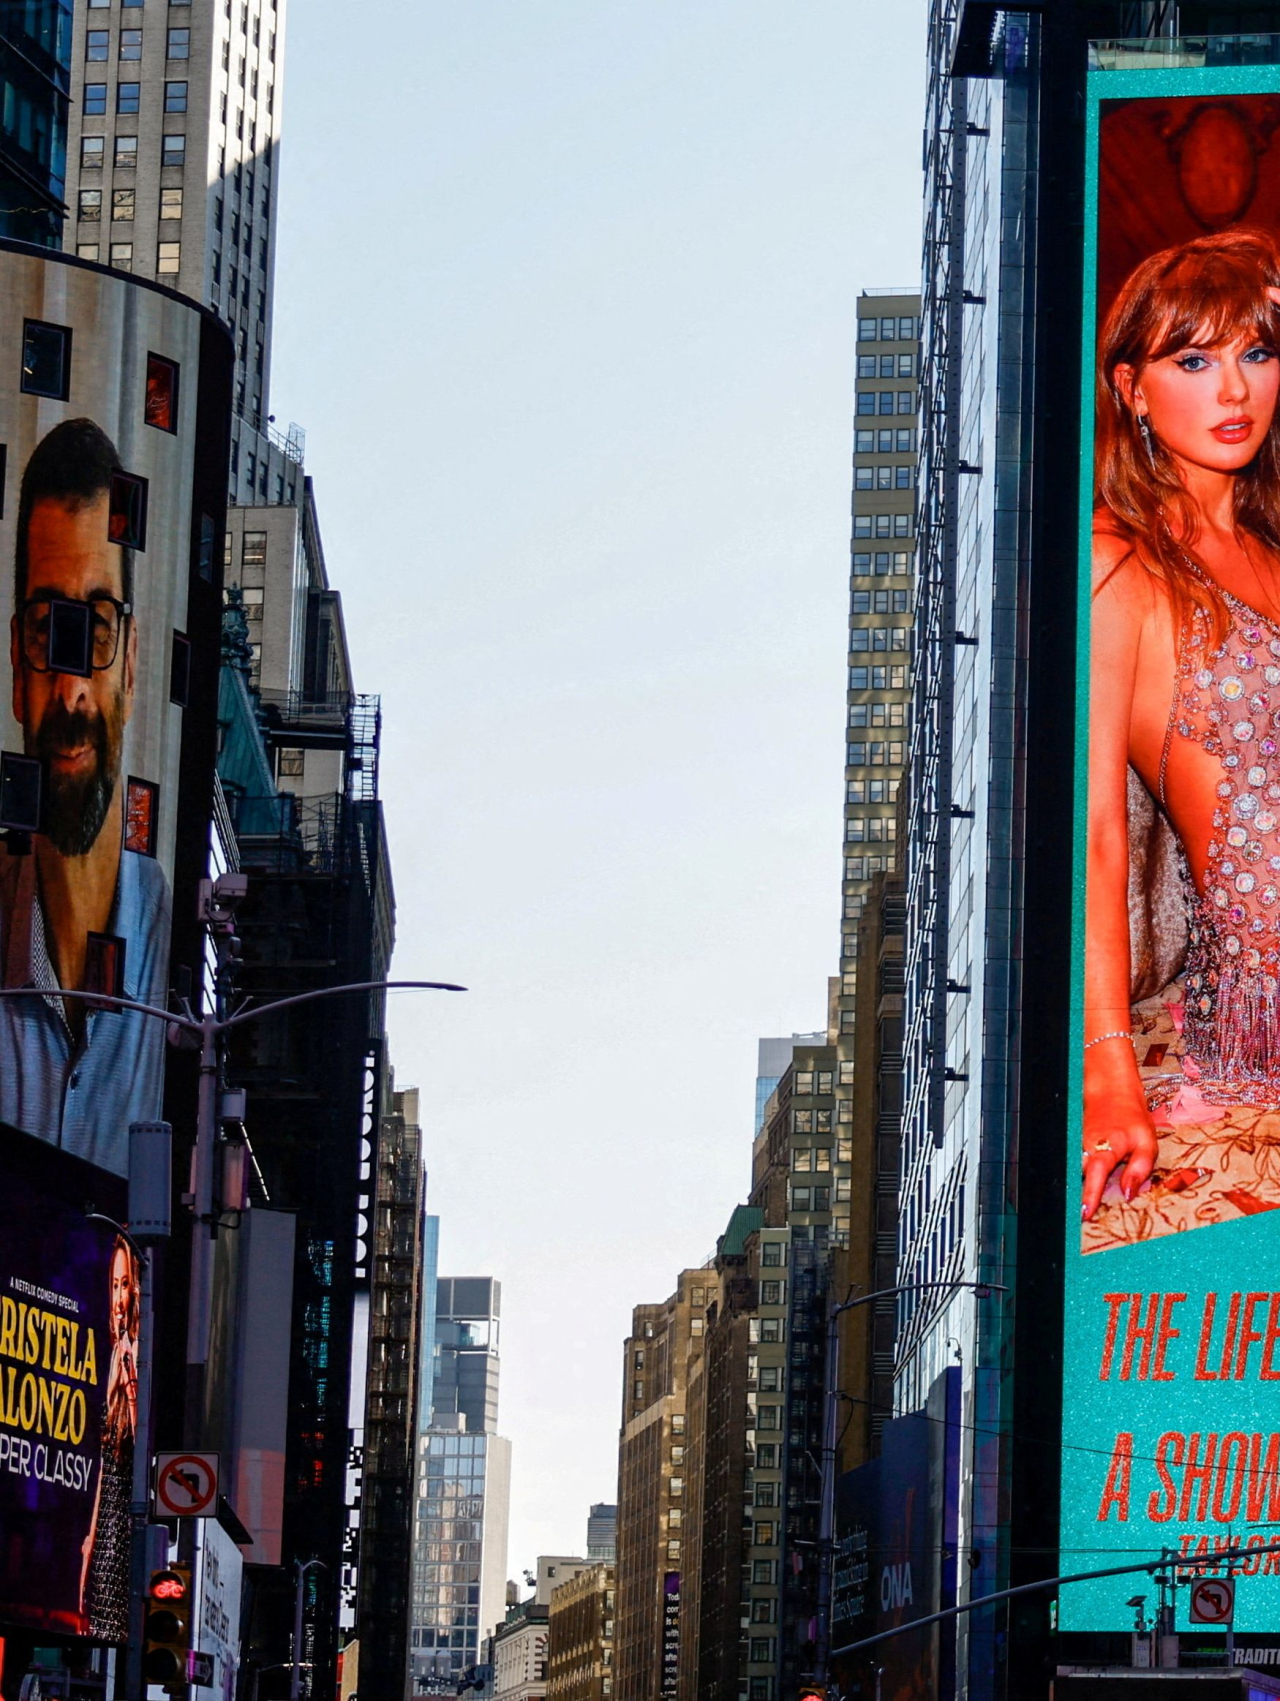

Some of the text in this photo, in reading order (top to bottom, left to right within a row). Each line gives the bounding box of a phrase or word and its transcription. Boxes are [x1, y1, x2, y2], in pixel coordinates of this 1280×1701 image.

[10, 1276, 79, 1313] A NETFLIX COMEDY SPECIAL
[0, 1294, 98, 1385] RISTELA
[1098, 1292, 1187, 1382] THE
[34, 1443, 93, 1492] CLASSY
[1097, 1432, 1133, 1522] A
[881, 1562, 913, 1612] ONA
